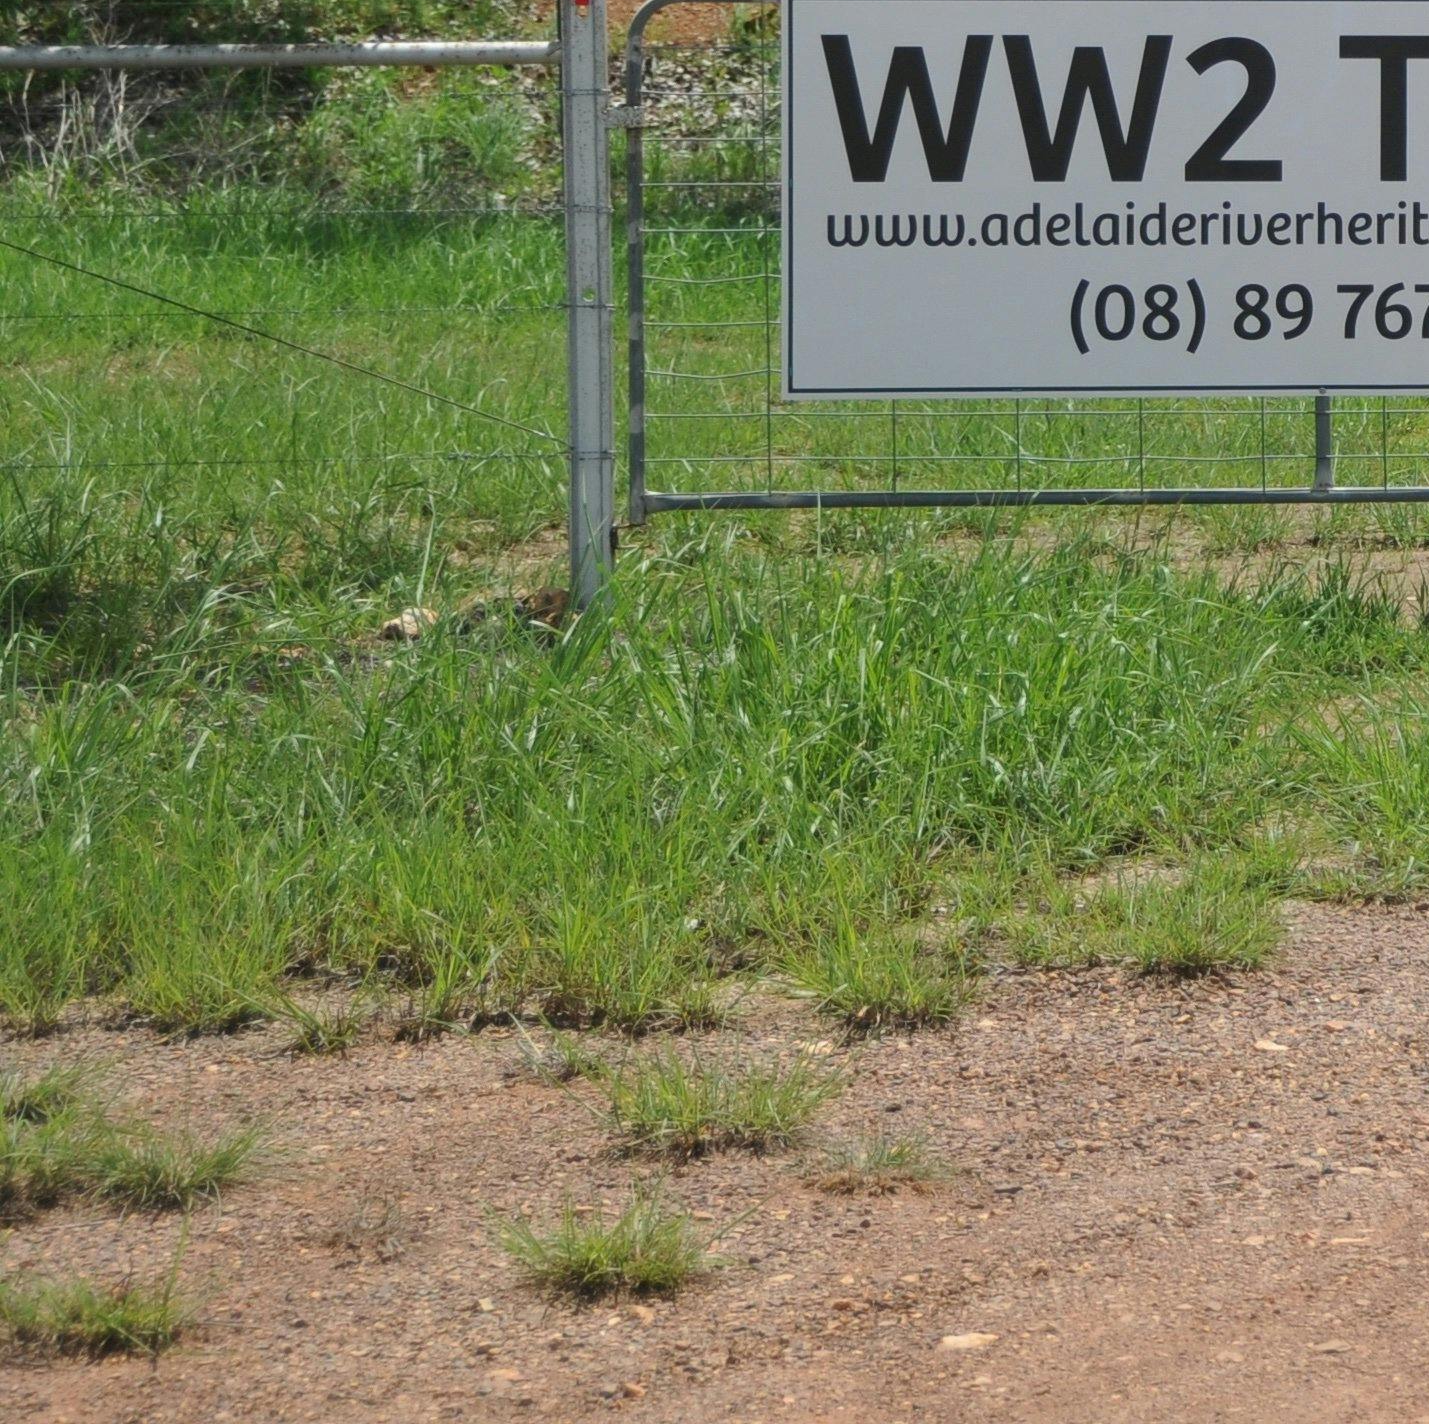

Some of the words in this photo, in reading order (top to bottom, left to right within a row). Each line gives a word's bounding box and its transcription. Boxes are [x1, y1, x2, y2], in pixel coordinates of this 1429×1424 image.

[820, 34, 1283, 183] WW2
[1070, 278, 1206, 355] (08)
[1233, 283, 1314, 341] 89
